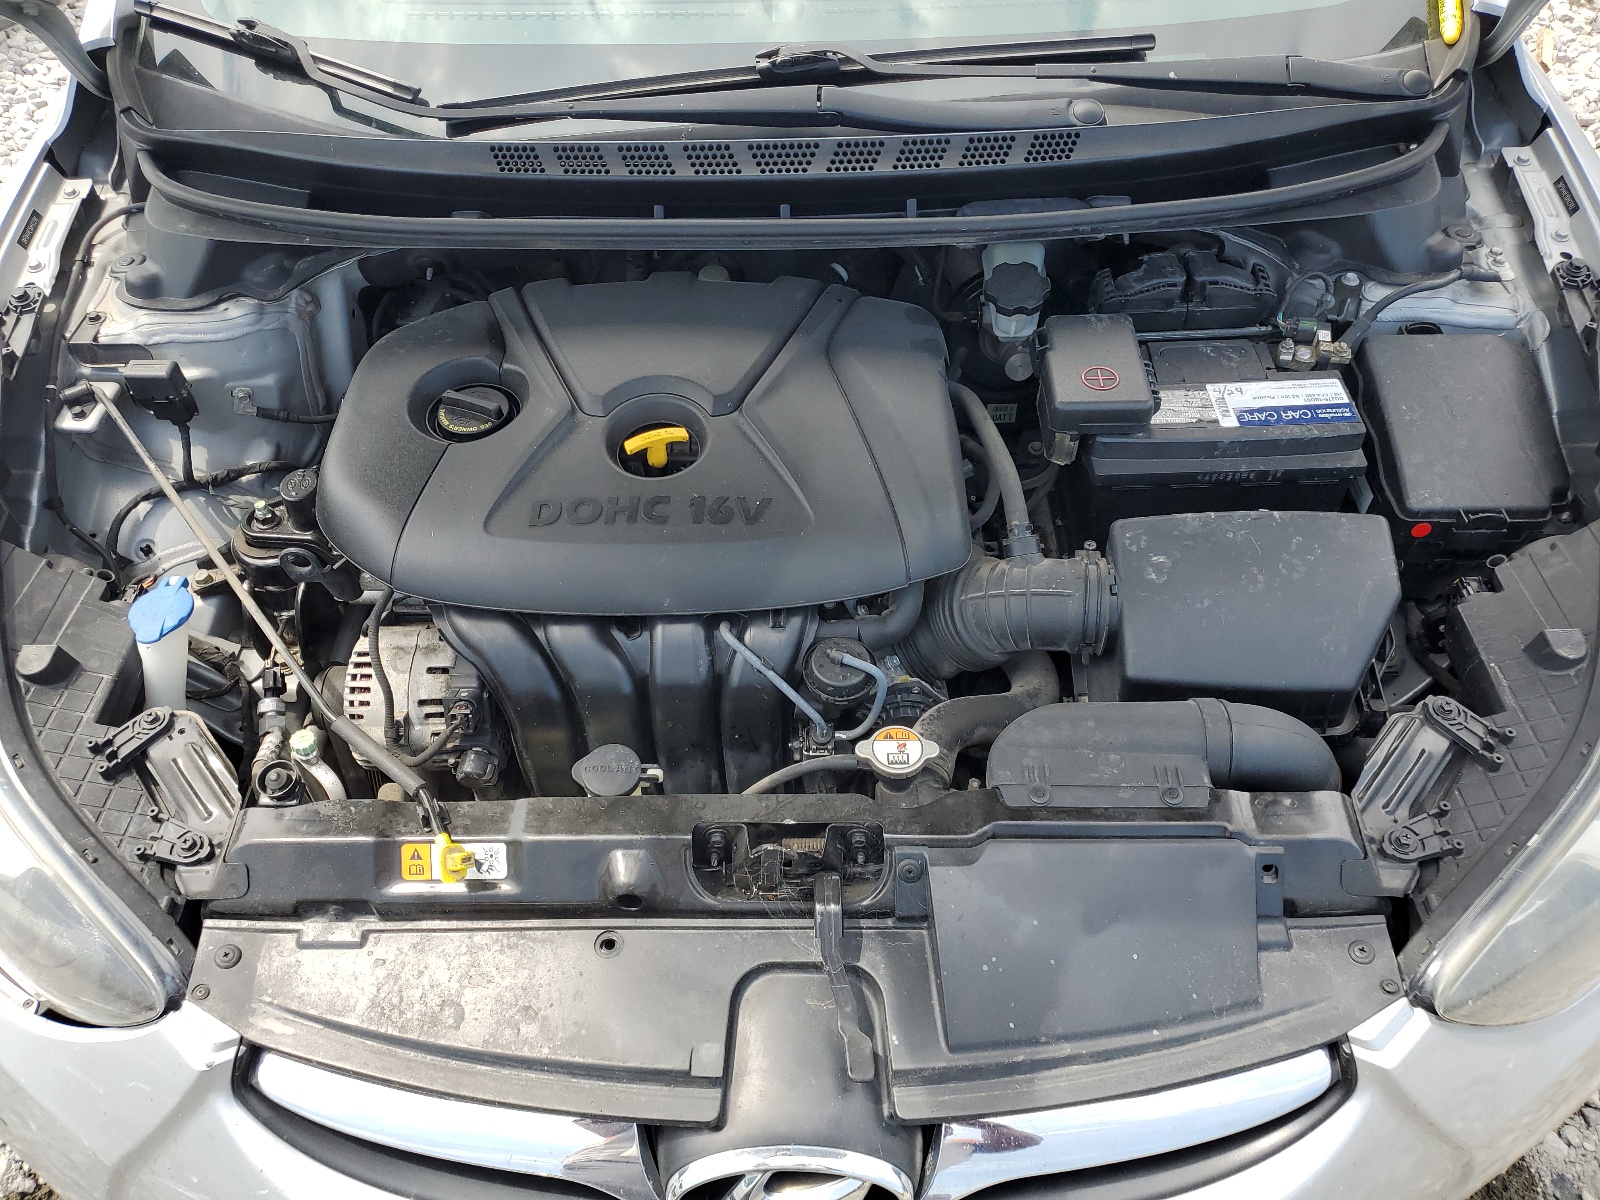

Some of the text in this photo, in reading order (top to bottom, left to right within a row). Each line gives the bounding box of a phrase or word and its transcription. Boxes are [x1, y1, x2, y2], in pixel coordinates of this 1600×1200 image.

[1238, 409, 1311, 422] CAR CARE
[528, 494, 772, 527] DOHC 16V
[585, 765, 639, 774] COOLANT
